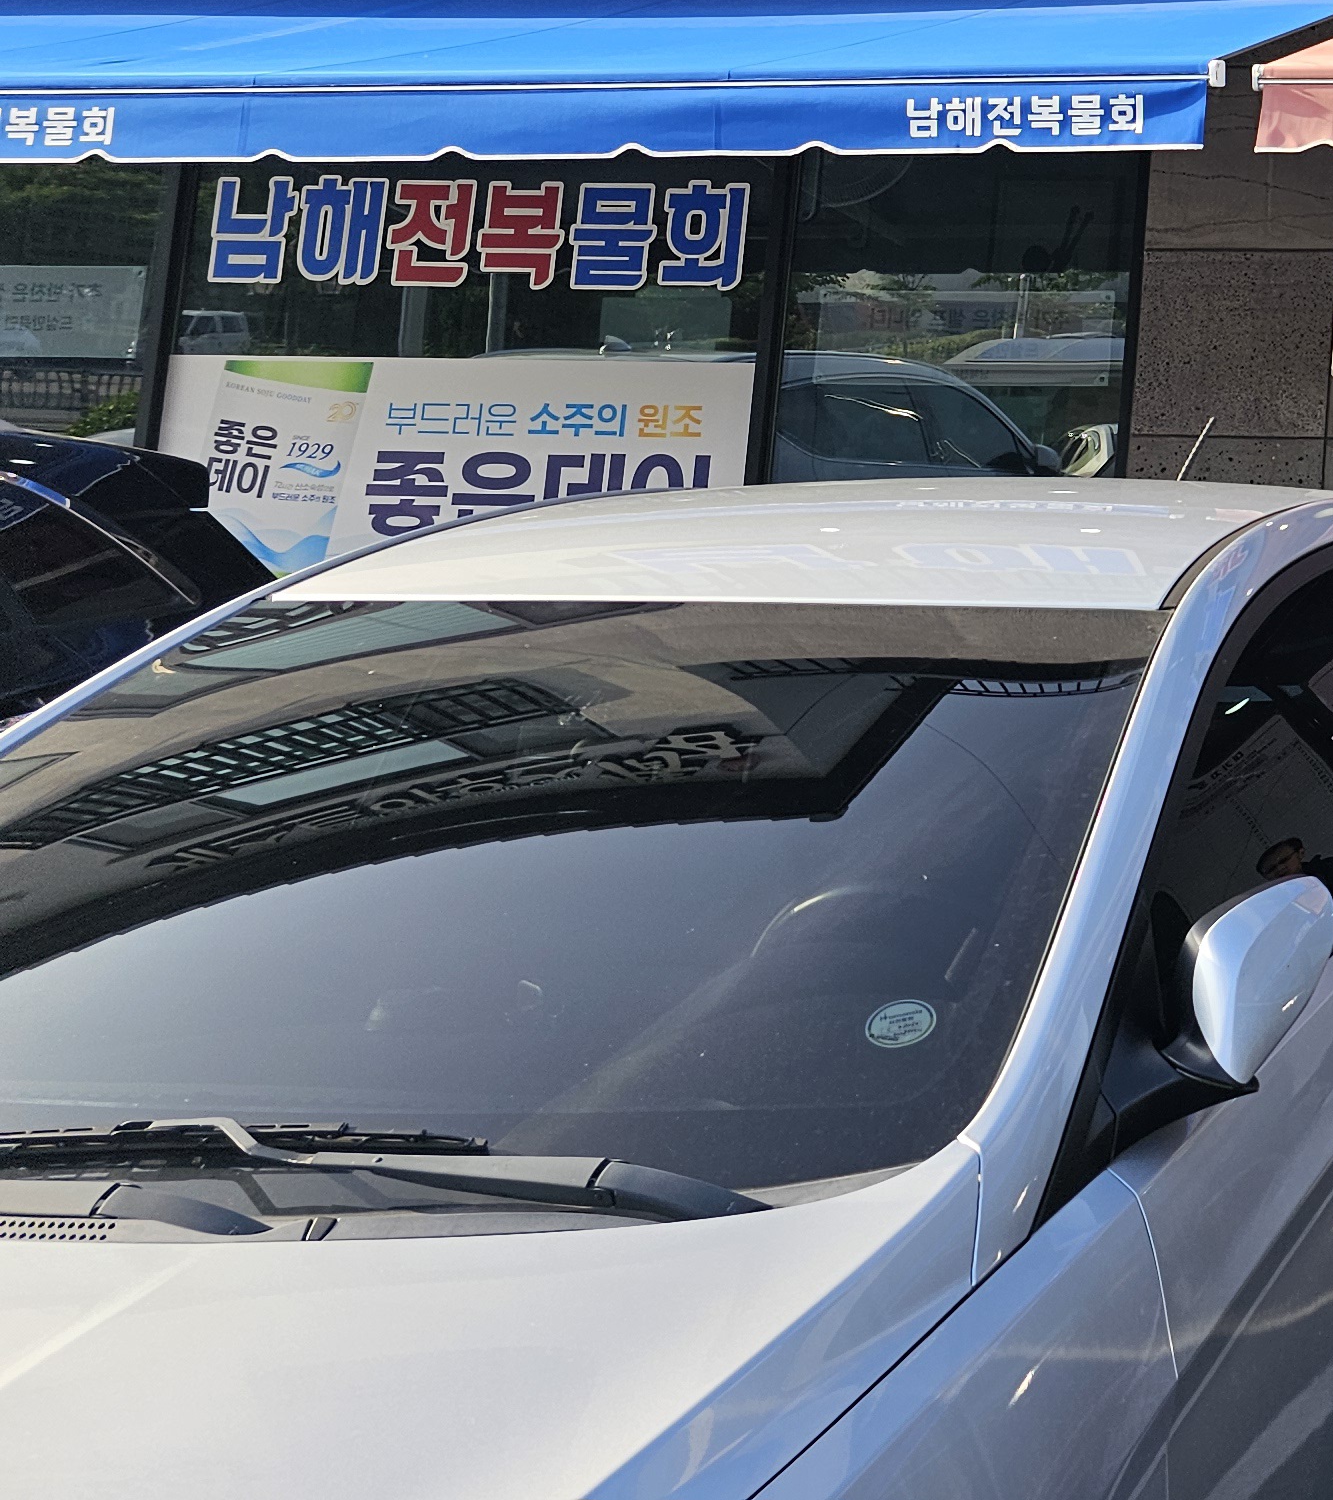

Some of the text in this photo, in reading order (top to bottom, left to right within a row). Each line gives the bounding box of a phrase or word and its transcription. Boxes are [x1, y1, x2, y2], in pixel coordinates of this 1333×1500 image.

[0, 105, 117, 147] 복물회
[906, 93, 1144, 138] 남해전복물회
[207, 174, 750, 292] 남해전복물회
[213, 418, 278, 460] 좋은
[385, 402, 705, 438] 부드러운 소주의 원조
[286, 441, 334, 461] 1929
[207, 456, 271, 498] 데이
[272, 492, 300, 502] 부드러운
[322, 495, 336, 504] 원조
